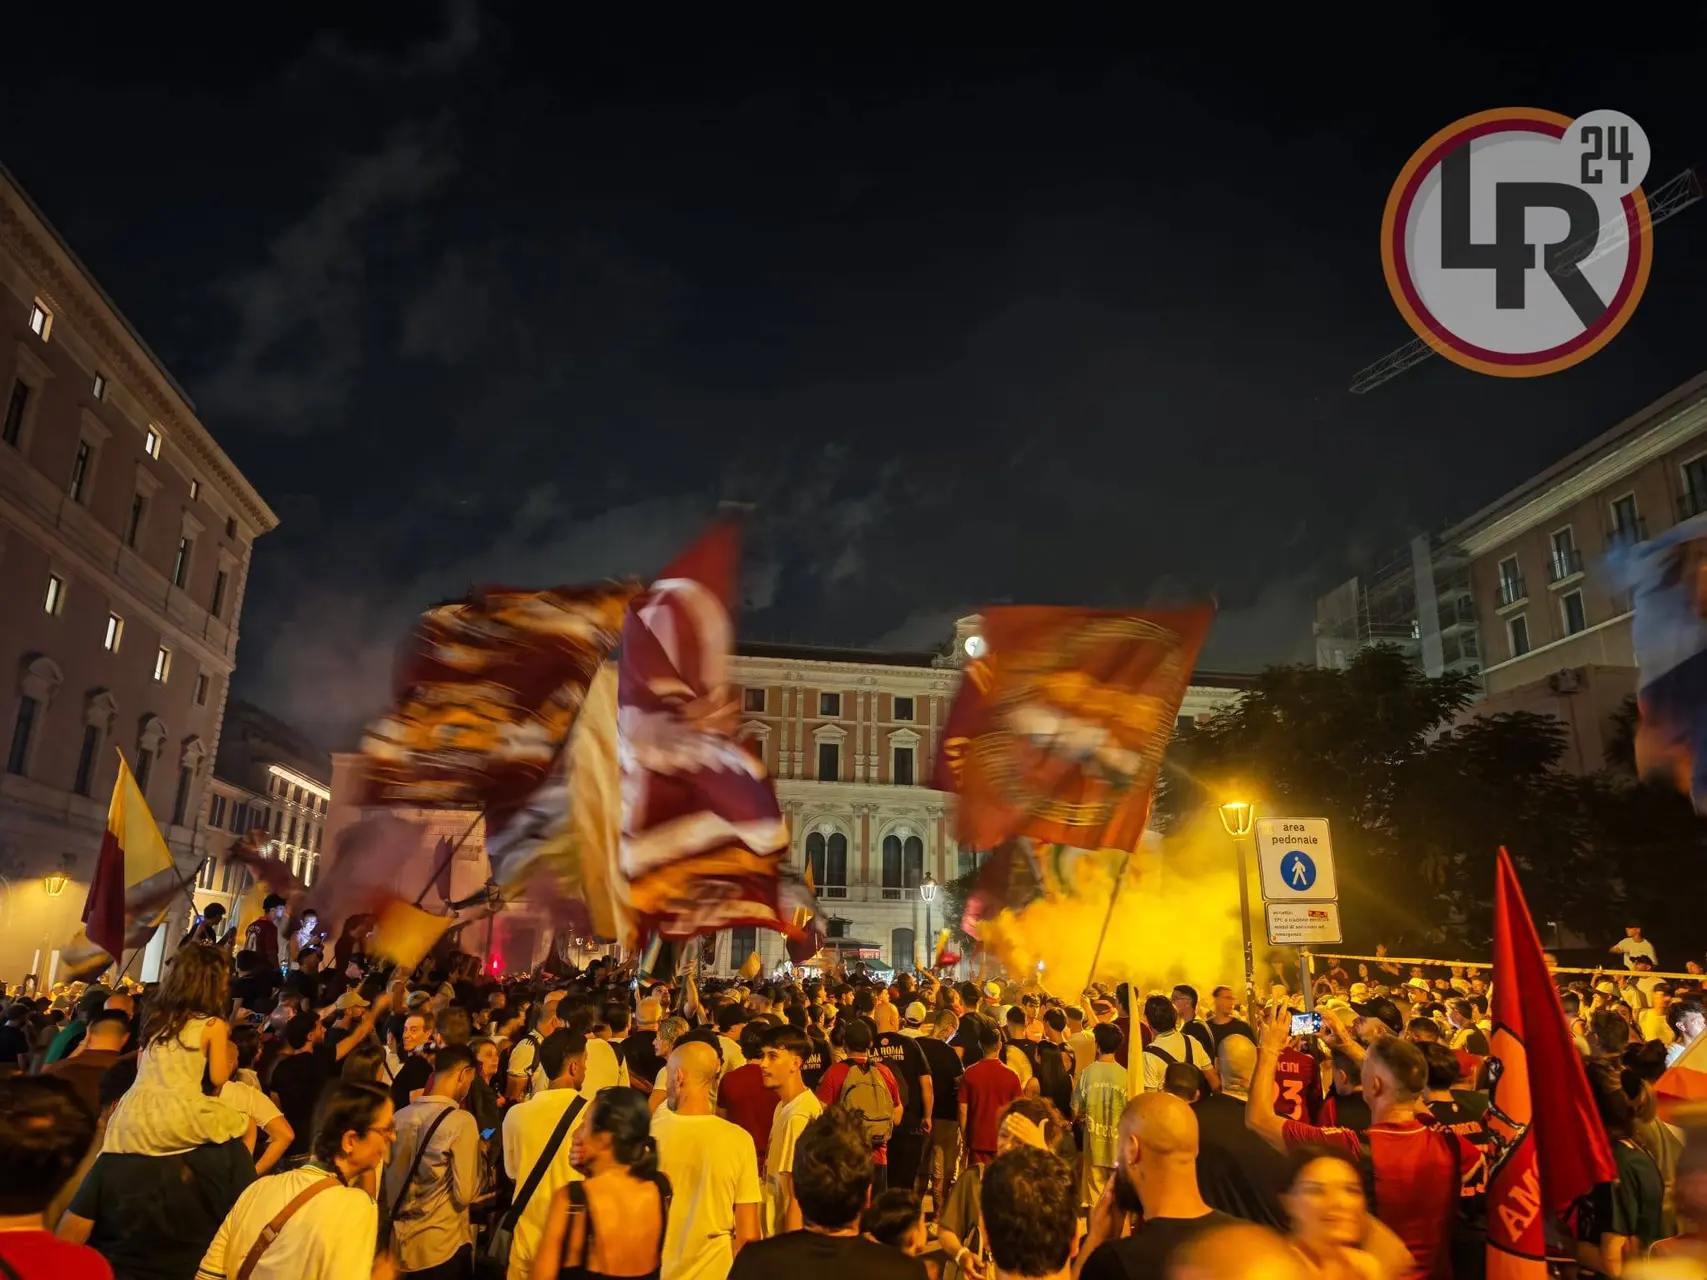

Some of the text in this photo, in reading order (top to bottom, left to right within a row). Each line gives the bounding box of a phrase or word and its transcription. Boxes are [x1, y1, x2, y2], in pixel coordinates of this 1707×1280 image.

[1282, 823, 1305, 832] area
[1271, 835, 1318, 845] pedonale
[880, 1045, 904, 1056] ROMA
[1498, 1149, 1541, 1243] AM
